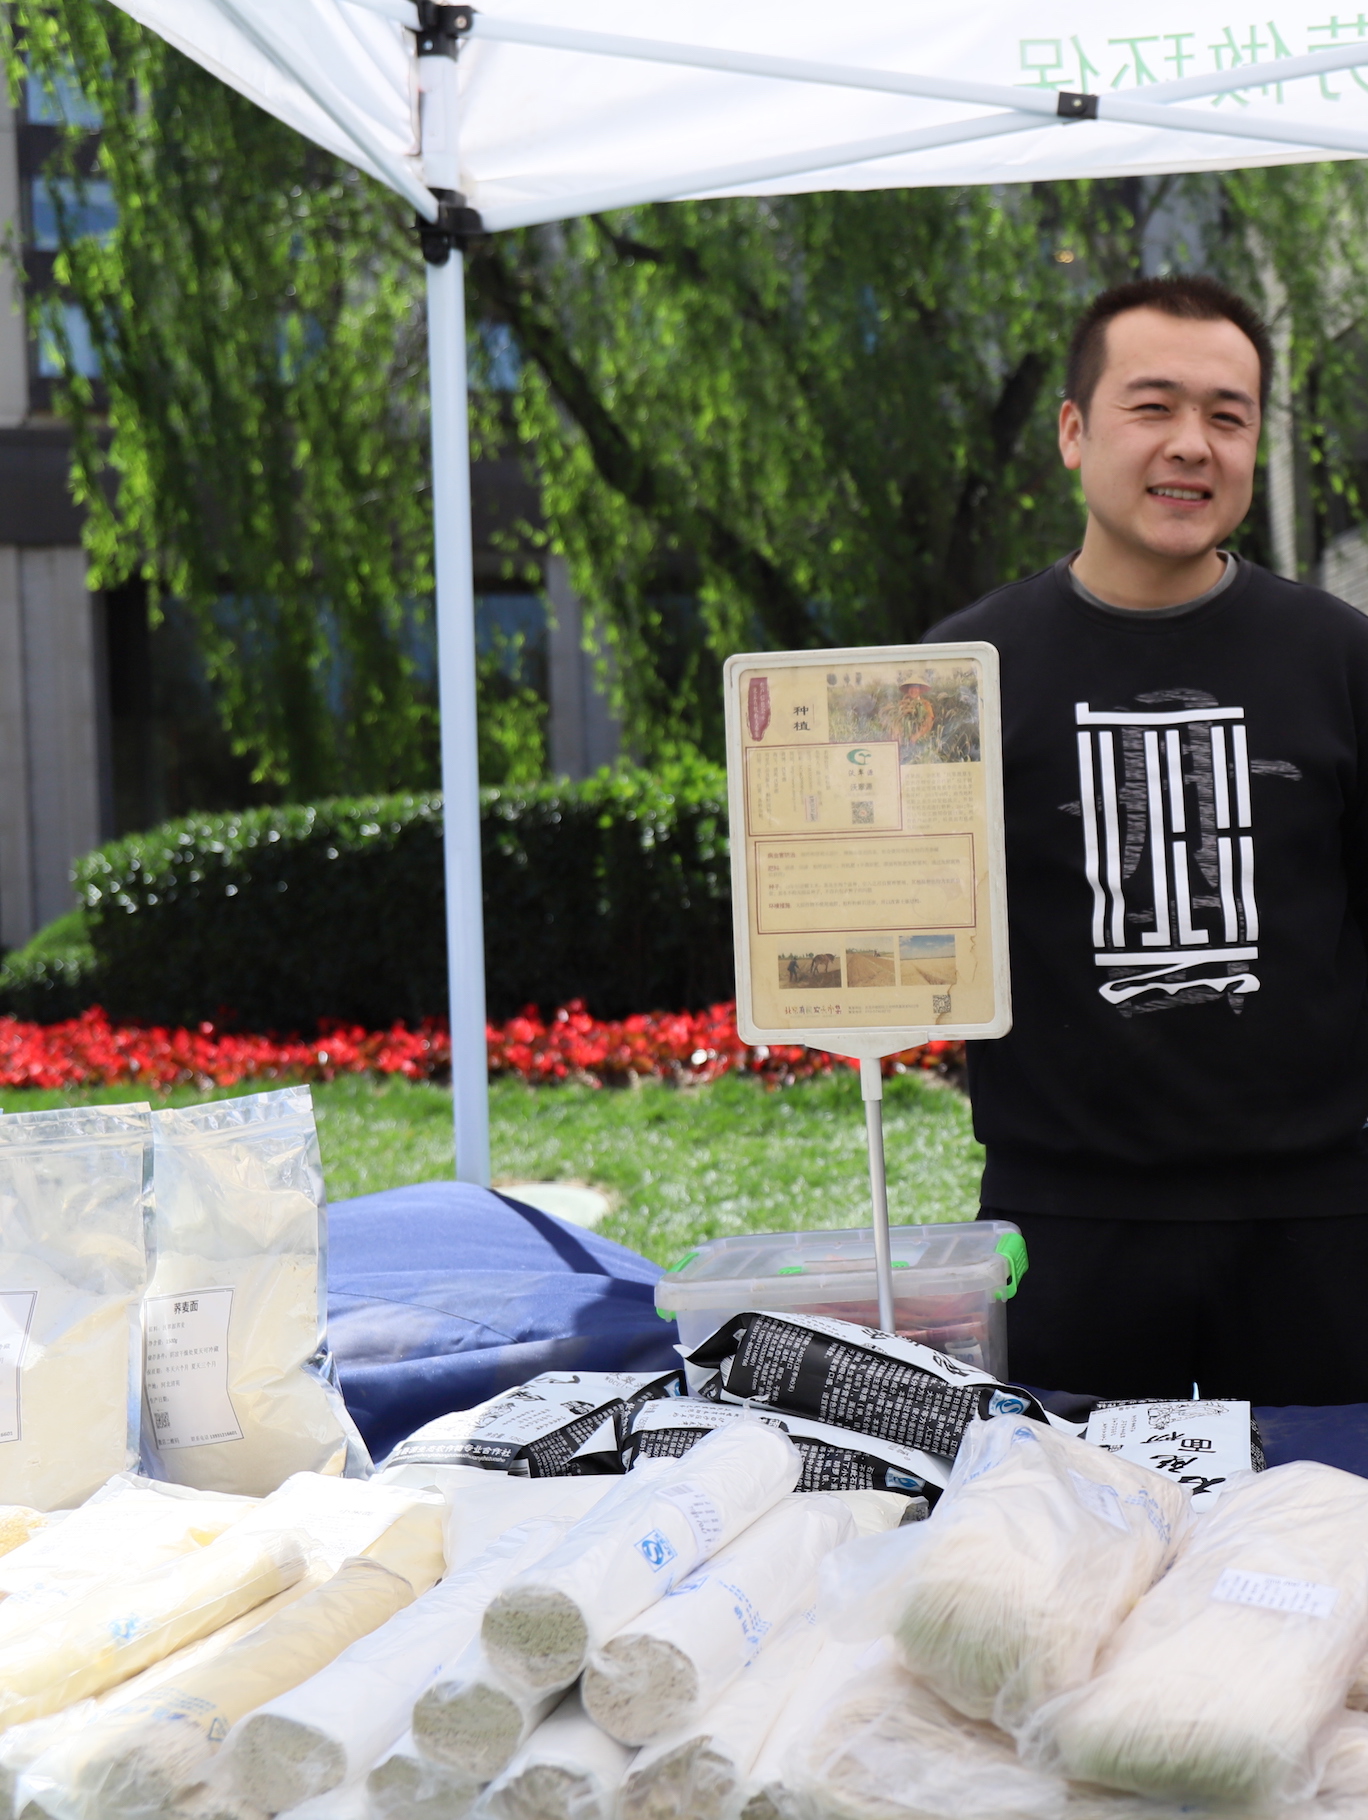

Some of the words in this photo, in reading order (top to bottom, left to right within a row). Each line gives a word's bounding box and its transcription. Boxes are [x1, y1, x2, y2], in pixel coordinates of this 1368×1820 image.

[793, 705, 811, 732] 种植
[174, 1300, 199, 1314] 荞麦面
